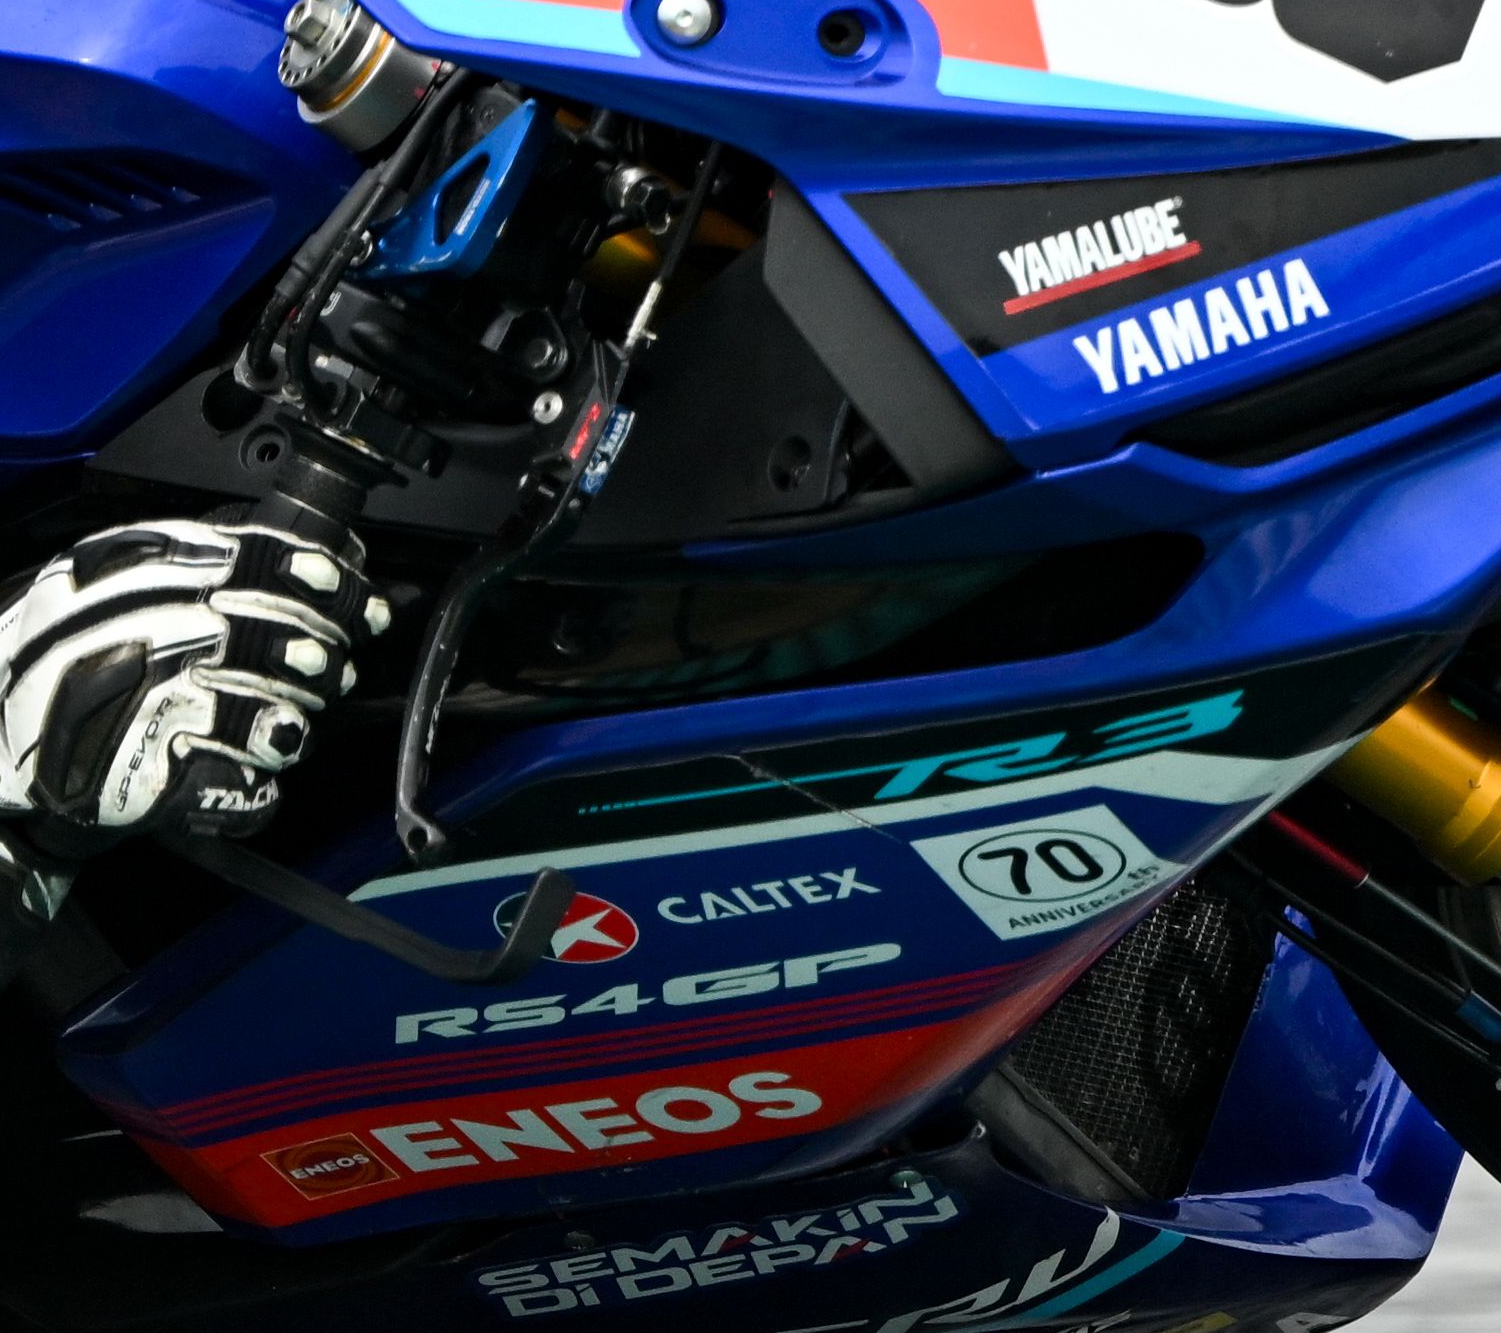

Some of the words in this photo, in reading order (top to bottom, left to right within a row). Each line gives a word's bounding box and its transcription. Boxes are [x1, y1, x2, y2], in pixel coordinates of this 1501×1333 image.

[1000, 203, 1188, 296] YAMALUBE
[1075, 259, 1330, 395] YAMAHA
[656, 867, 881, 924] CALTEX
[977, 839, 1103, 895] 70
[289, 1152, 370, 1181] ENEOS
[373, 1072, 822, 1174] ENEOS
[618, 1197, 960, 1303] DEPAN
